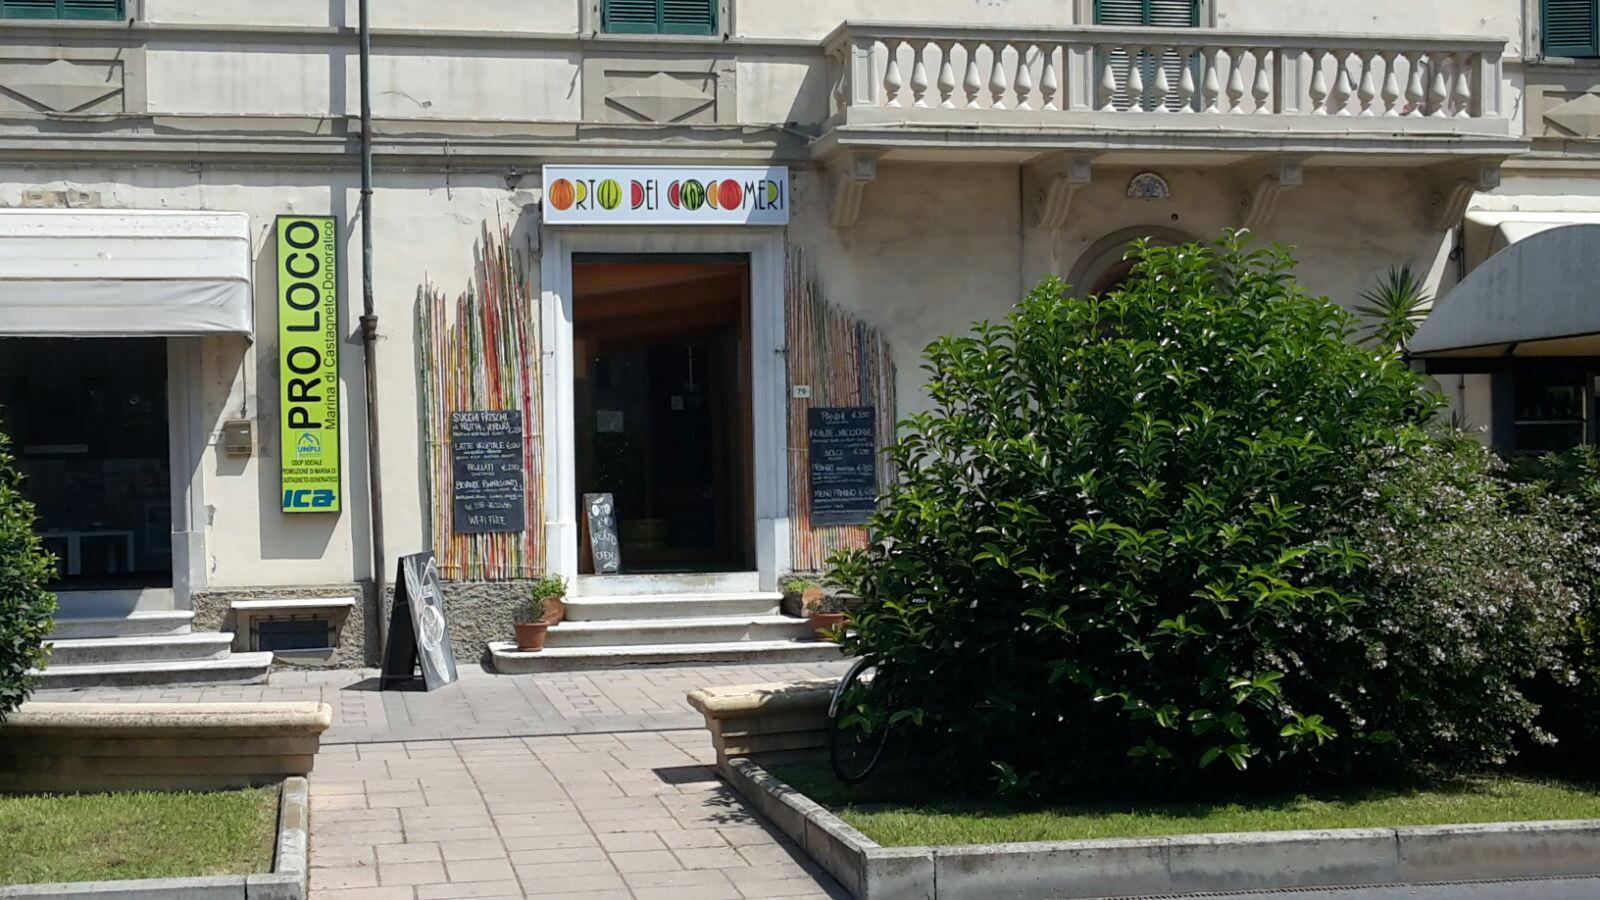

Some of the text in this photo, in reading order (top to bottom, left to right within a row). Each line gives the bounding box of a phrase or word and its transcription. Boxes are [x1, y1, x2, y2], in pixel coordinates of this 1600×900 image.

[549, 178, 784, 211] ORTO DEI COCOMERI
[285, 221, 321, 332] LOCO
[322, 221, 336, 430] Marina di Castagneto-Donoratico
[286, 346, 322, 429] PRO
